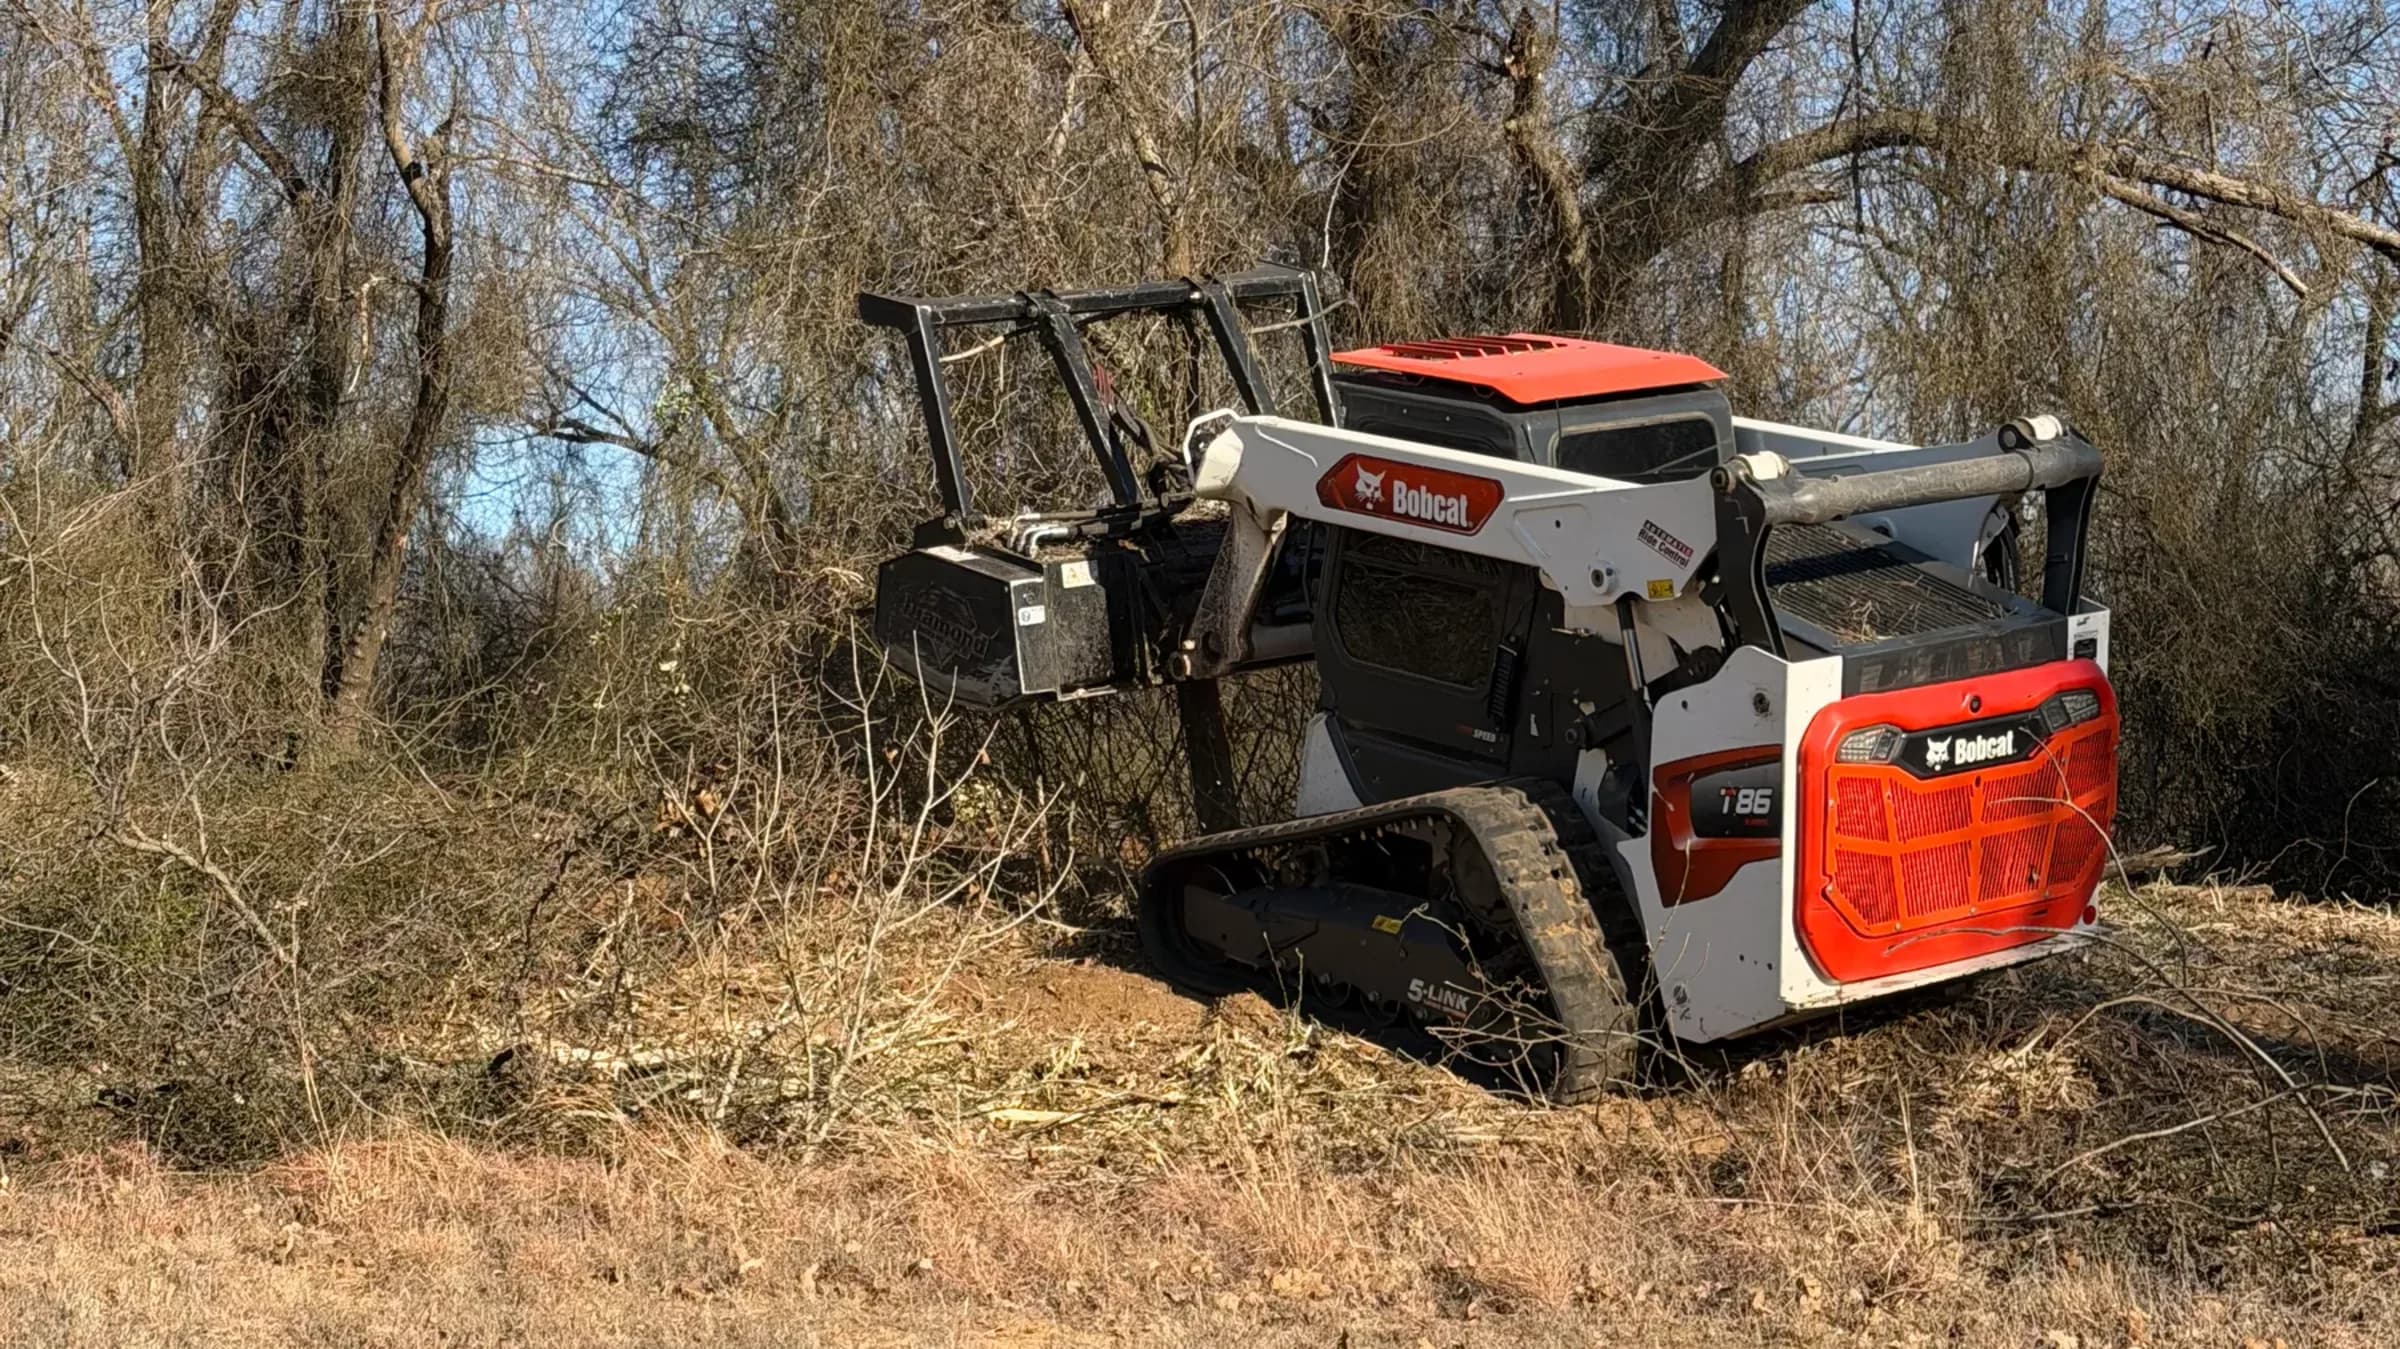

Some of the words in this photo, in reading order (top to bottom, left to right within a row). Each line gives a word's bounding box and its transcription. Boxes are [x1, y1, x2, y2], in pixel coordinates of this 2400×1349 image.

[1392, 480, 1469, 528] Bobcat
[1638, 528, 1658, 547] Ride
[1658, 541, 1690, 568] Control
[1473, 728, 1497, 743] SPEED
[1954, 730, 2014, 765] Bobcat
[1720, 788, 1773, 815] T86
[1407, 978, 1470, 1011] 5-LINK
